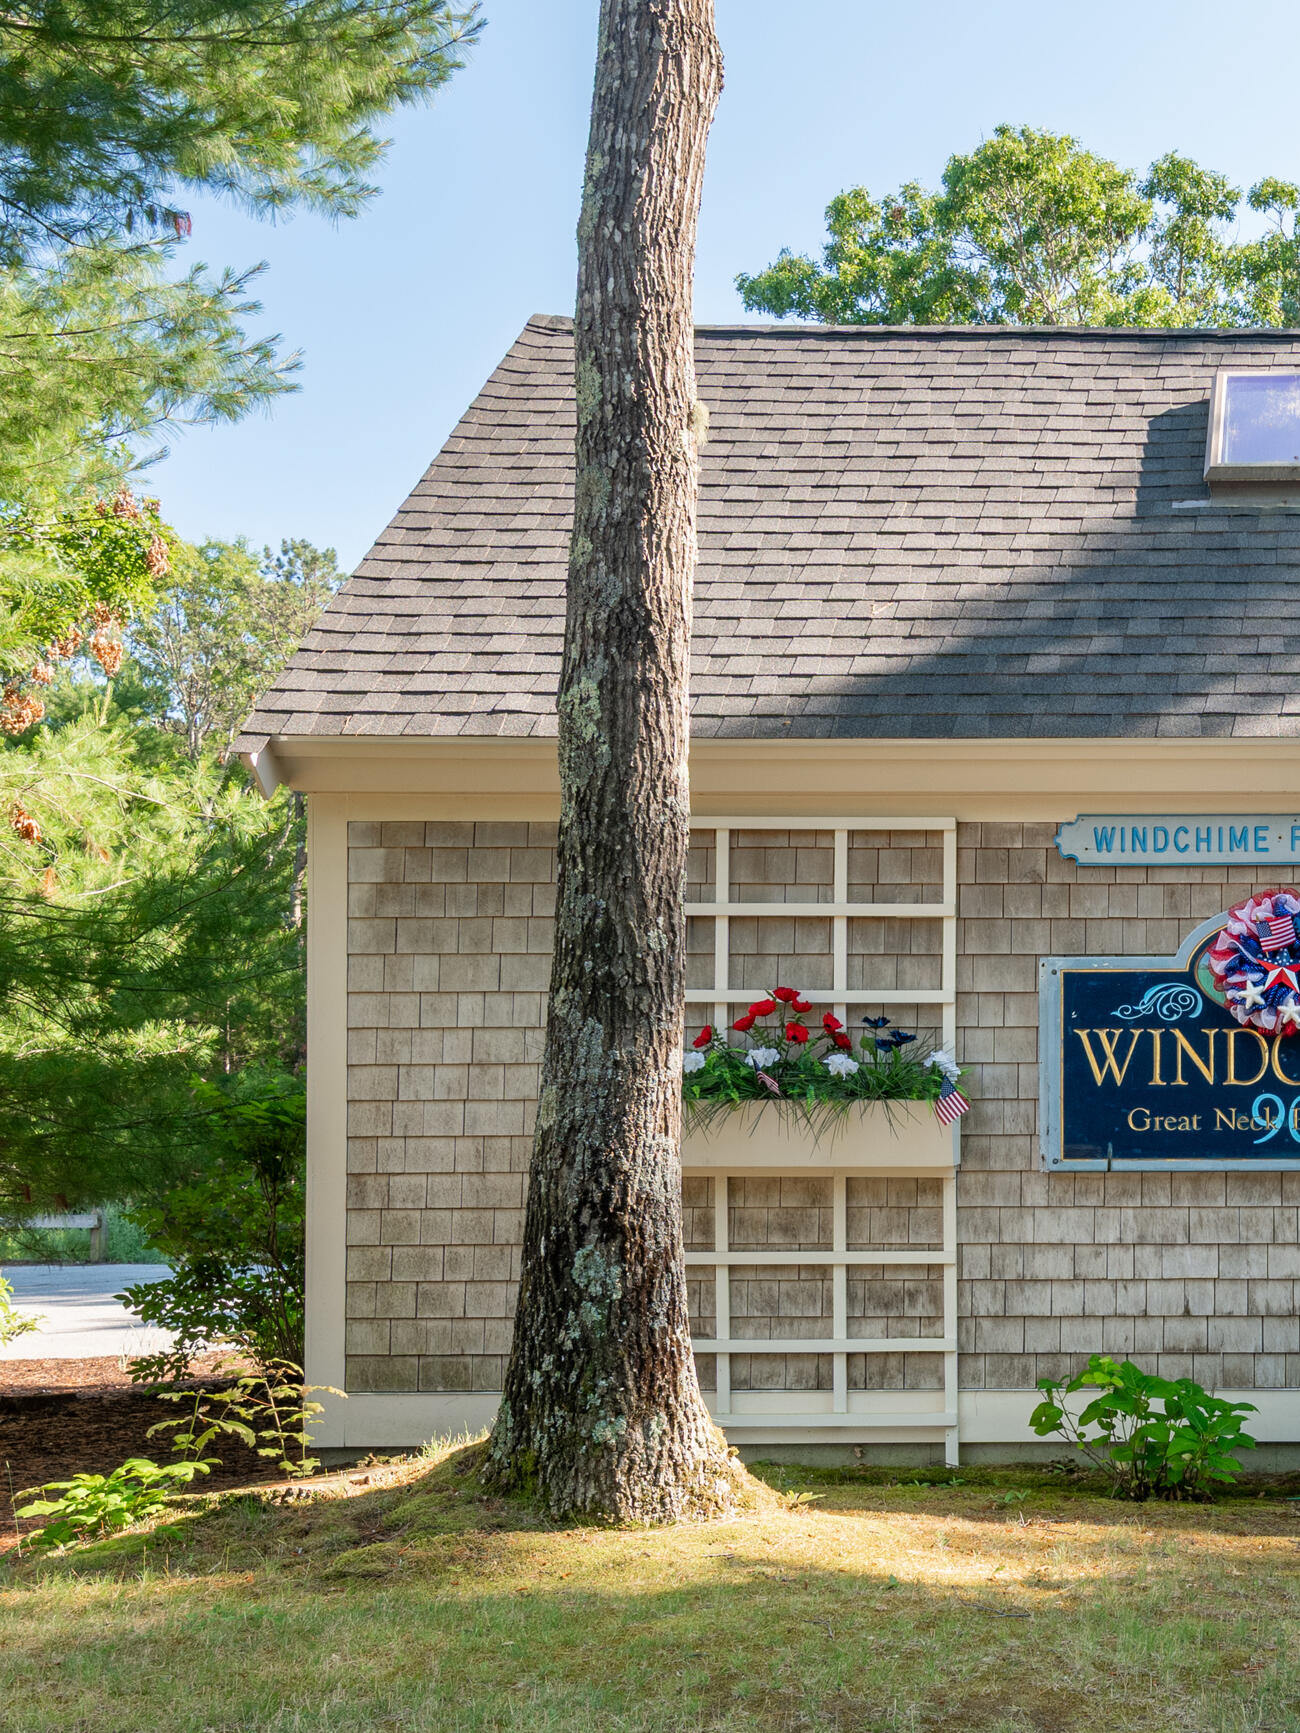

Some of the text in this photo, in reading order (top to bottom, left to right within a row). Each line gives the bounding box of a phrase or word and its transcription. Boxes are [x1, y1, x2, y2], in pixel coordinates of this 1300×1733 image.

[1093, 826, 1270, 853] WINDCHIME
[1127, 1107, 1202, 1132] Great
[1213, 1106, 1280, 1132] Neck
